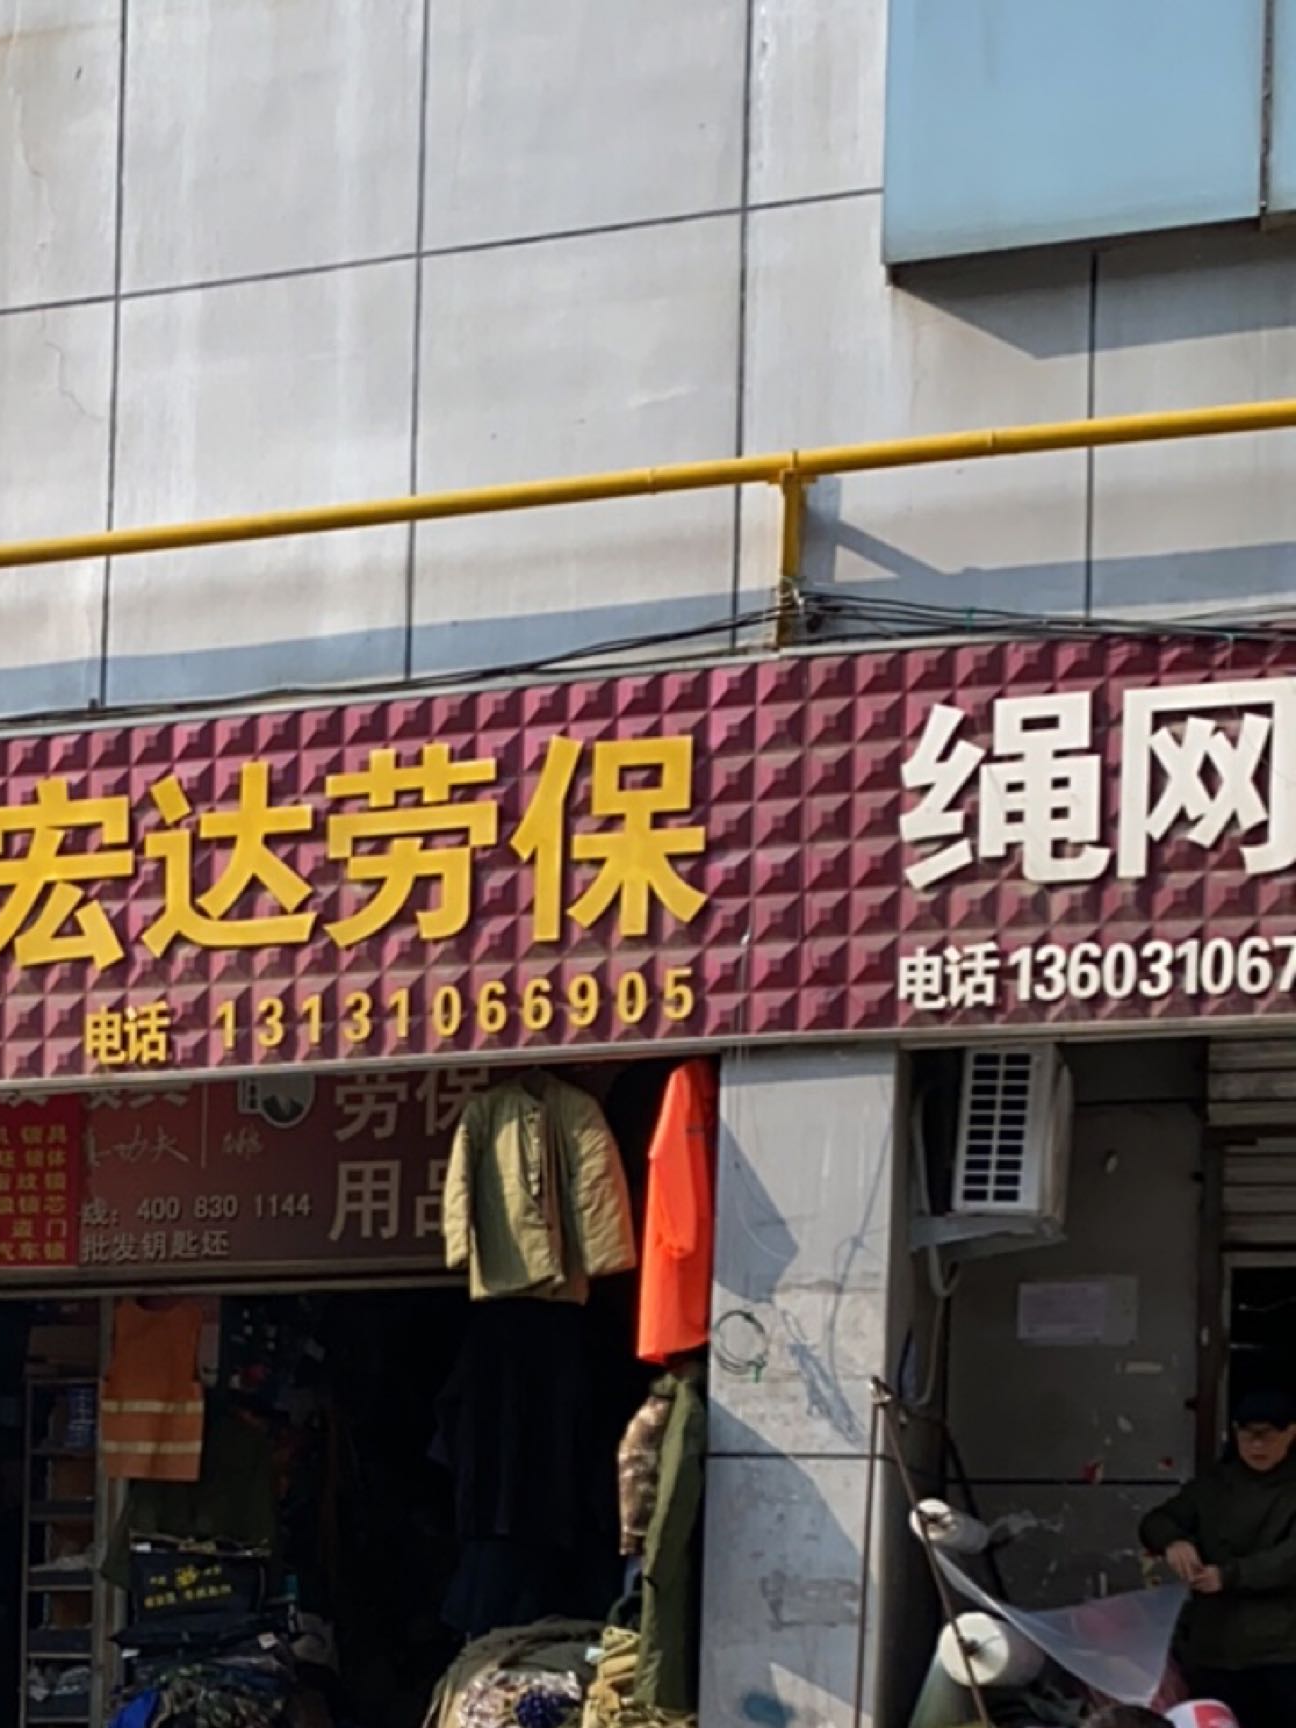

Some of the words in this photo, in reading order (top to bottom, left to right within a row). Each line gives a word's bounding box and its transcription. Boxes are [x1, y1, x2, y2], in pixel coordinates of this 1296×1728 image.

[899, 678, 1296, 889] 绳网
[84, 1002, 170, 1066] 电话
[216, 967, 694, 1051] 13131066905
